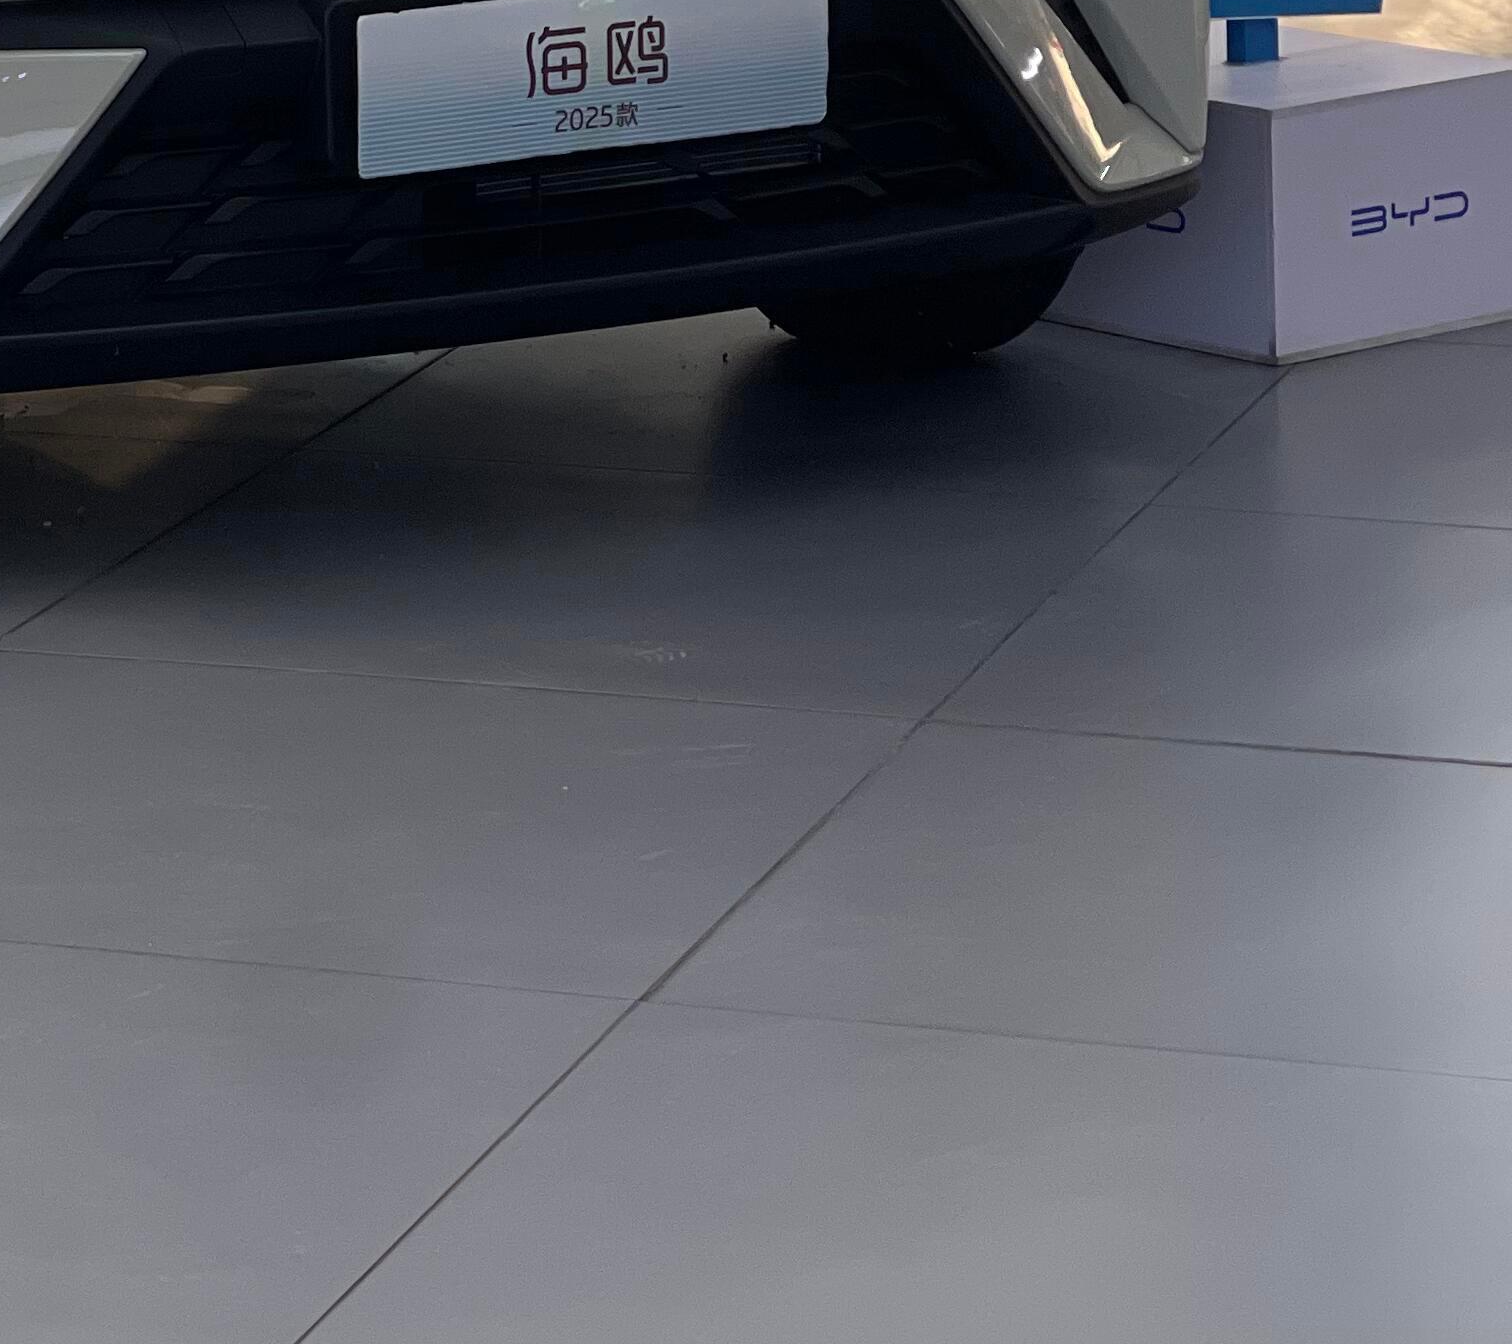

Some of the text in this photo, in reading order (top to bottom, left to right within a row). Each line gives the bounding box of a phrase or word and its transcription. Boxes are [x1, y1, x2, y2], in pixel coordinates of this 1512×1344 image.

[525, 14, 669, 99] 海鸥
[553, 101, 640, 134] 2025款
[1350, 190, 1470, 237] BYD
